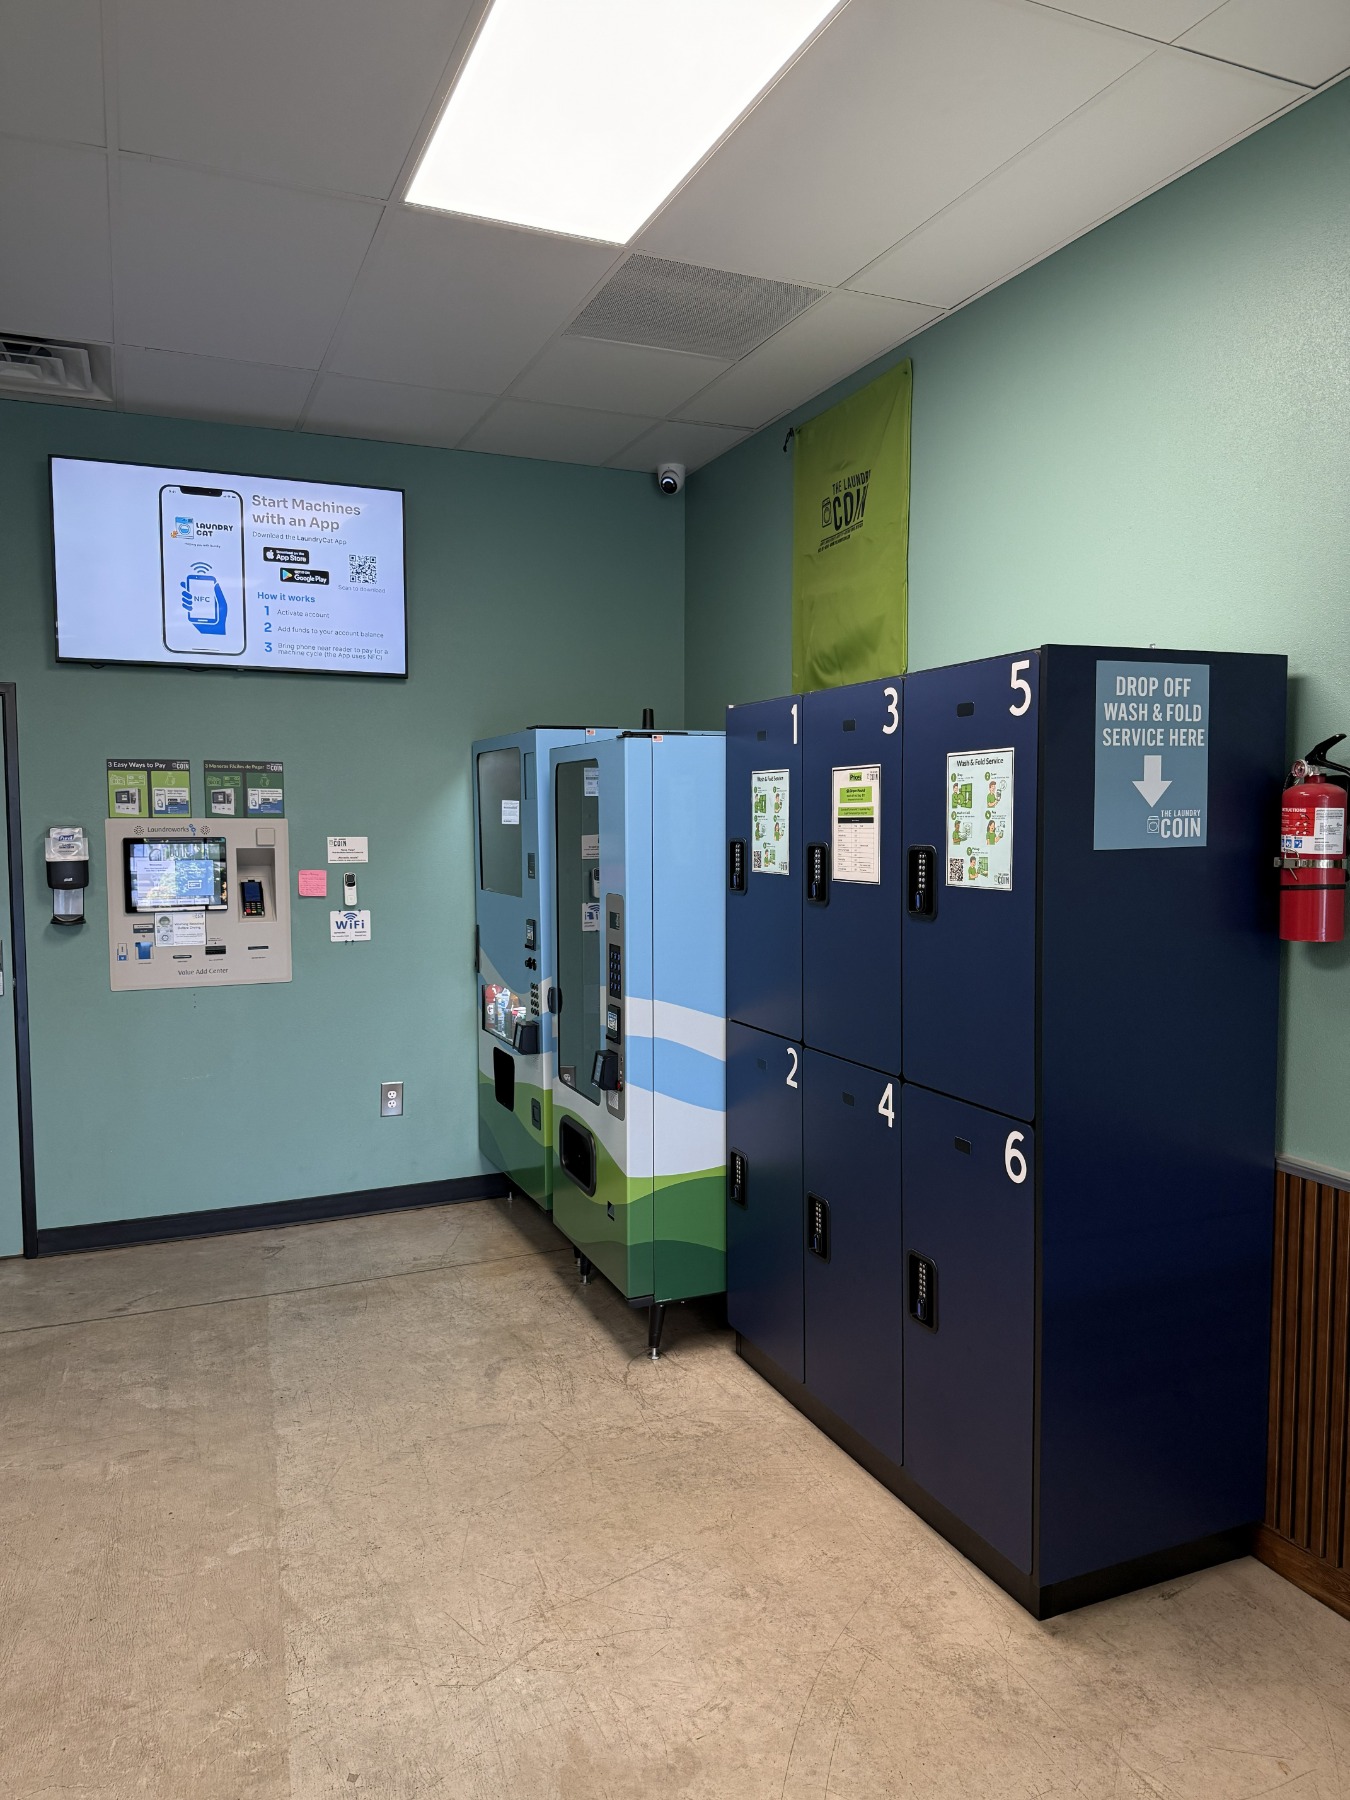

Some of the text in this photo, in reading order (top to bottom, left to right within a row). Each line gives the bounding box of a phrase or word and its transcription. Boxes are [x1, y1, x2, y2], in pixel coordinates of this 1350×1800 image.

[832, 469, 871, 495] THE LAUNDRY
[252, 495, 361, 516] Start Machines
[833, 483, 869, 531] COIN
[195, 522, 233, 532] LAUNDRY
[252, 512, 340, 532] with an App
[252, 531, 284, 540] Download
[296, 535, 333, 544] LaundryCat
[276, 554, 307, 563] App Store
[294, 574, 327, 584] Google Play
[257, 592, 316, 603] How it works
[359, 586, 386, 594] download
[264, 606, 330, 619] 1 Activate account
[264, 622, 272, 632] 2
[292, 626, 310, 634] funds
[334, 629, 359, 637] account
[264, 642, 272, 652] 3
[278, 643, 294, 651] Bring
[296, 644, 316, 652] phone
[1008, 660, 1032, 717] 5
[1116, 676, 1192, 698] DROP OFF
[882, 686, 899, 735] 3
[1104, 702, 1202, 722] WASH & FOLD
[791, 704, 798, 744] 1
[1102, 728, 1205, 747] SERVICE HERE
[970, 758, 974, 766] &
[975, 758, 985, 766] Fold
[986, 757, 1004, 765] Service
[1161, 809, 1201, 817] THE LAUNDRY
[1160, 818, 1201, 838] COIN
[997, 876, 1010, 885] COIN
[335, 920, 365, 930] WiFi
[786, 1048, 798, 1089] 2
[877, 1082, 895, 1128] 4
[1004, 1130, 1027, 1184] 6
